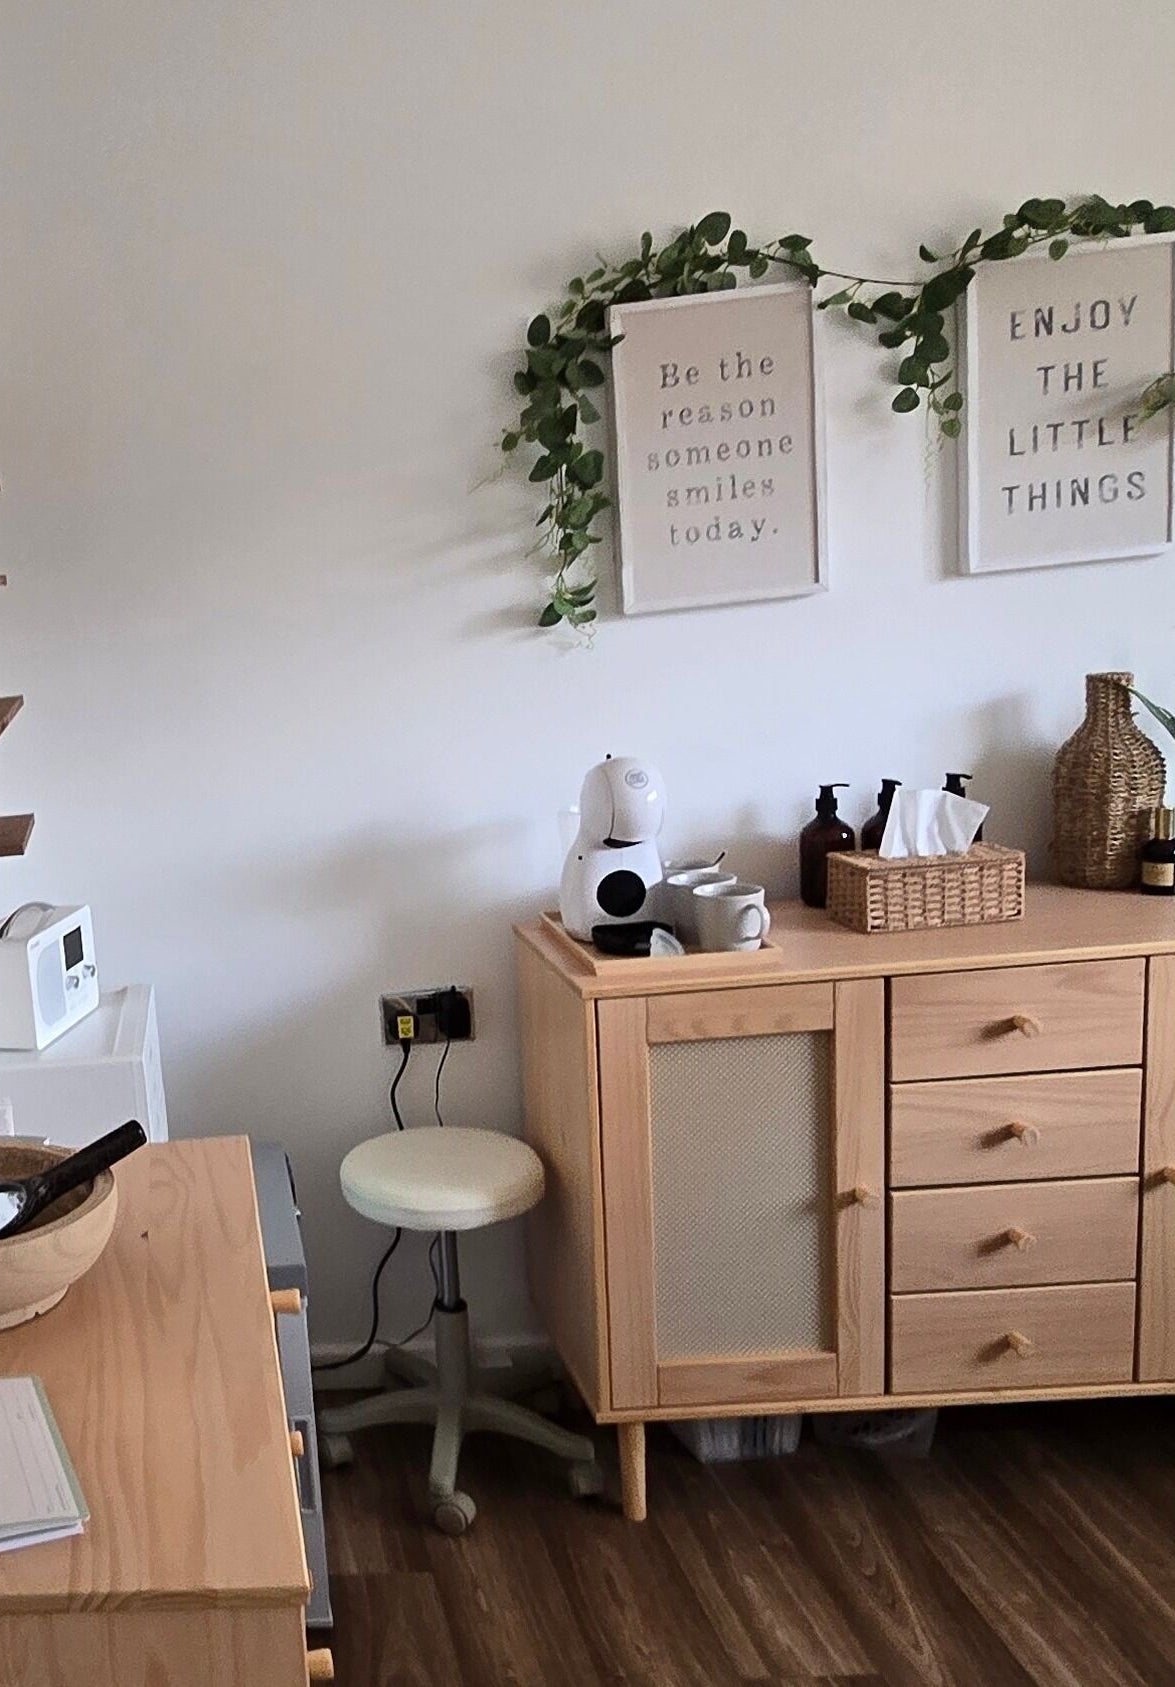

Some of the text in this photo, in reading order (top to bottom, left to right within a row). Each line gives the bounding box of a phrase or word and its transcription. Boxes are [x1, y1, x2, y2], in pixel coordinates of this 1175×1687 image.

[1010, 296, 1137, 341] ENJOY
[660, 352, 775, 389] Be the
[1037, 359, 1108, 395] THE
[662, 396, 776, 428] reason
[647, 435, 793, 471] someone
[666, 475, 775, 507] smiles
[1002, 471, 1145, 515] THINGS
[669, 517, 779, 545] today.
